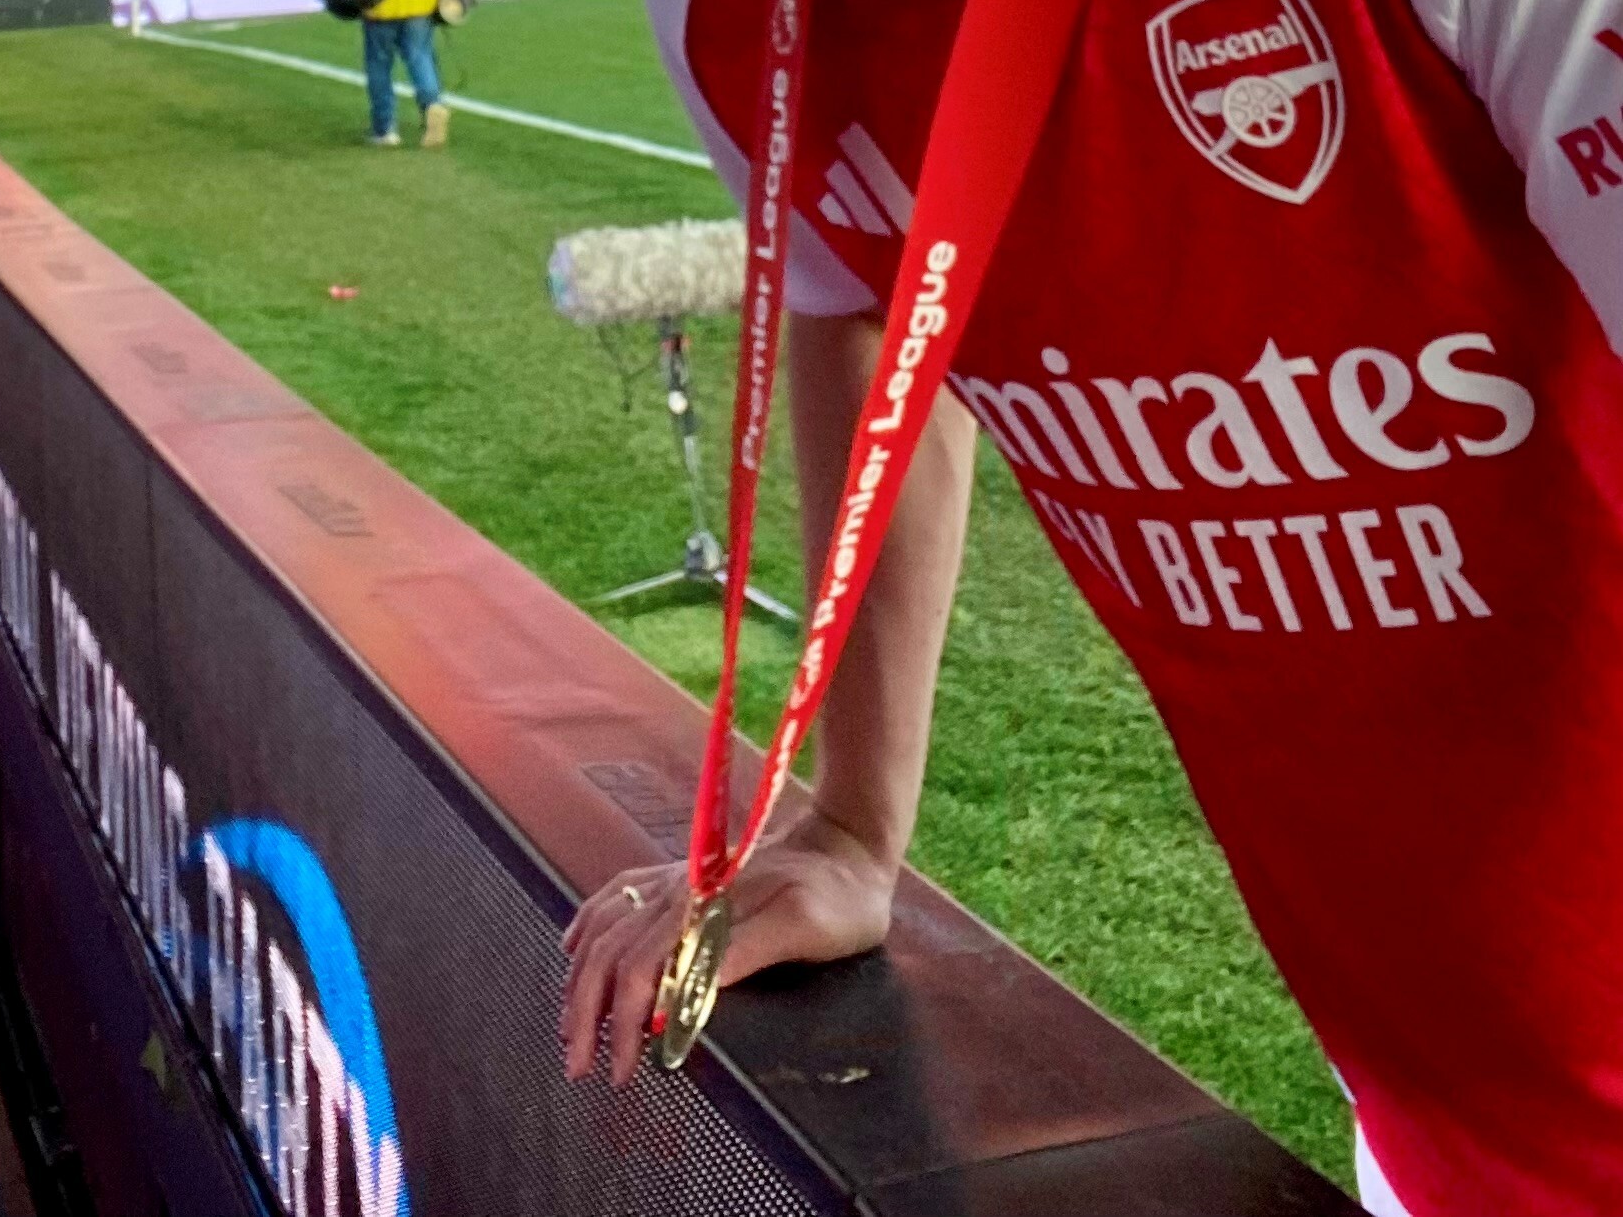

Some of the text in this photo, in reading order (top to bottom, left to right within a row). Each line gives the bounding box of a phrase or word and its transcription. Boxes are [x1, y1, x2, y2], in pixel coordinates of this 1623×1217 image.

[1176, 12, 1300, 75] Arsenal
[756, 67, 791, 260] League
[812, 239, 958, 632] Premier League
[945, 332, 1536, 490] mirates
[1137, 503, 1494, 633] BETTER
